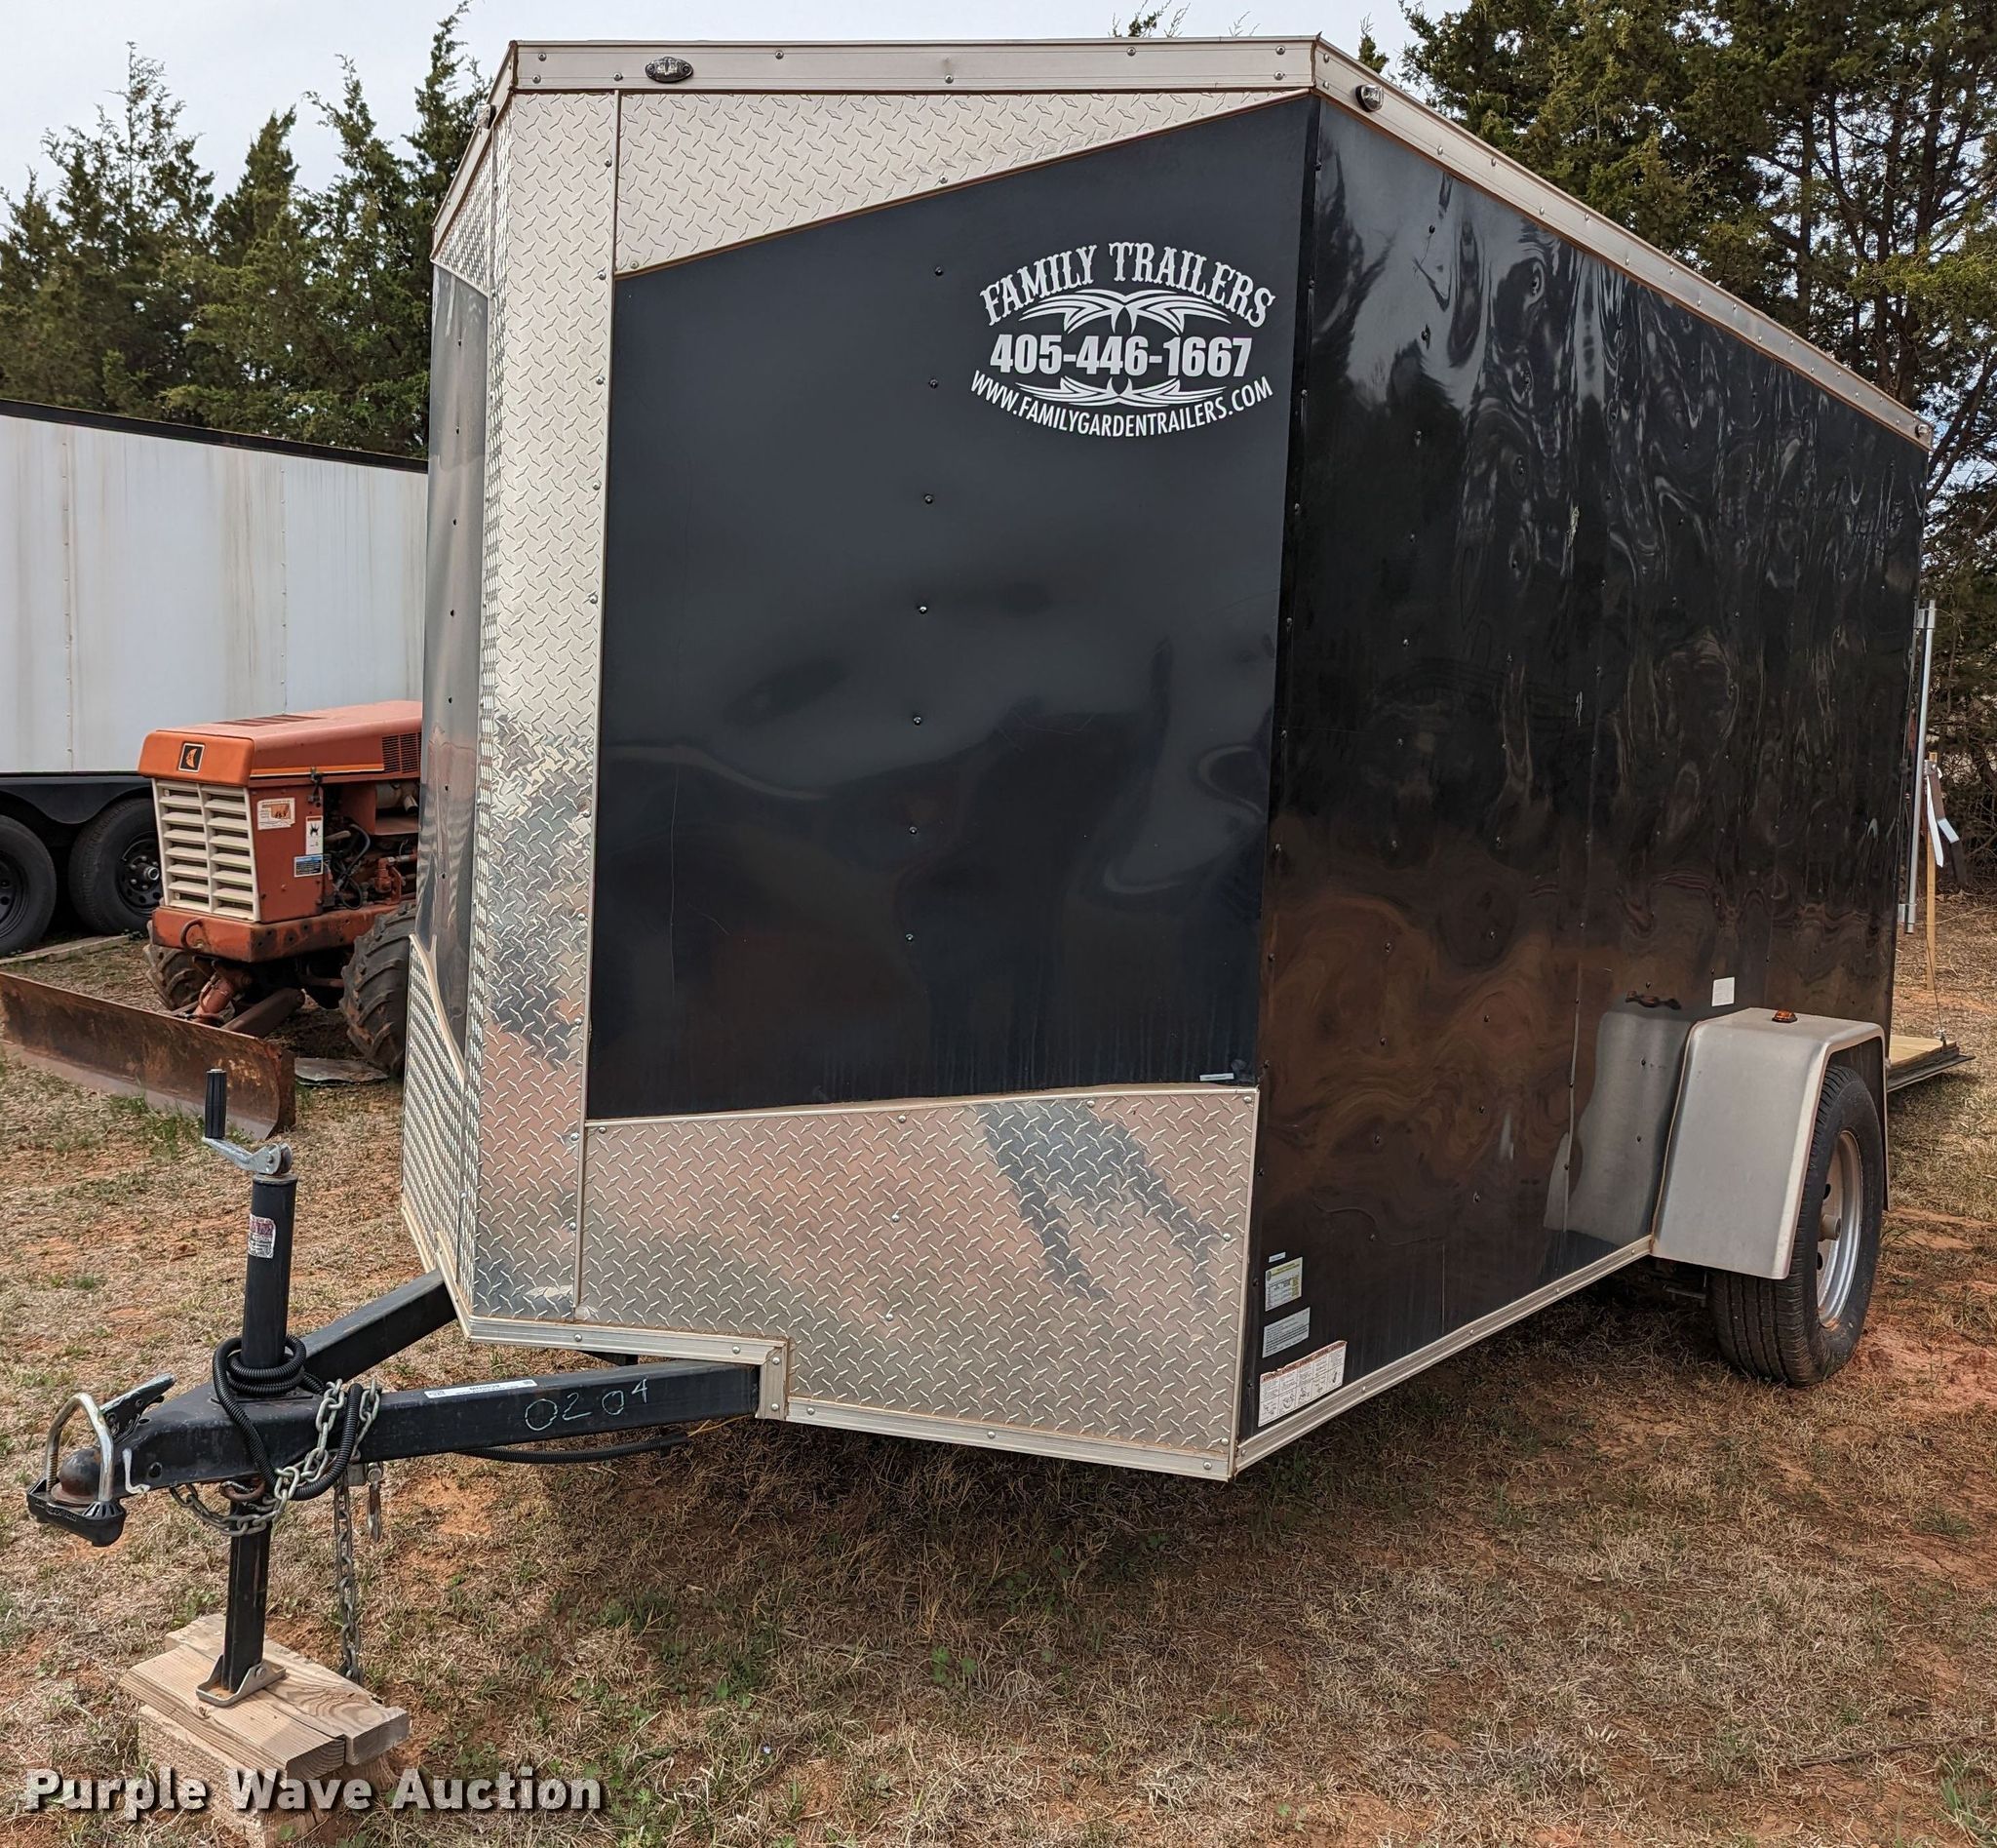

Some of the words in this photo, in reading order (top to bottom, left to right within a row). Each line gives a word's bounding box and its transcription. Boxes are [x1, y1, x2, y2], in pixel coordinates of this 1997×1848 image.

[979, 244, 1098, 327] FAMILY
[1108, 241, 1276, 329] TRAILERS
[989, 334, 1253, 377] 405-446-1667
[970, 369, 1274, 438] WWW.FAMILYGARDENTRAILERS.COM
